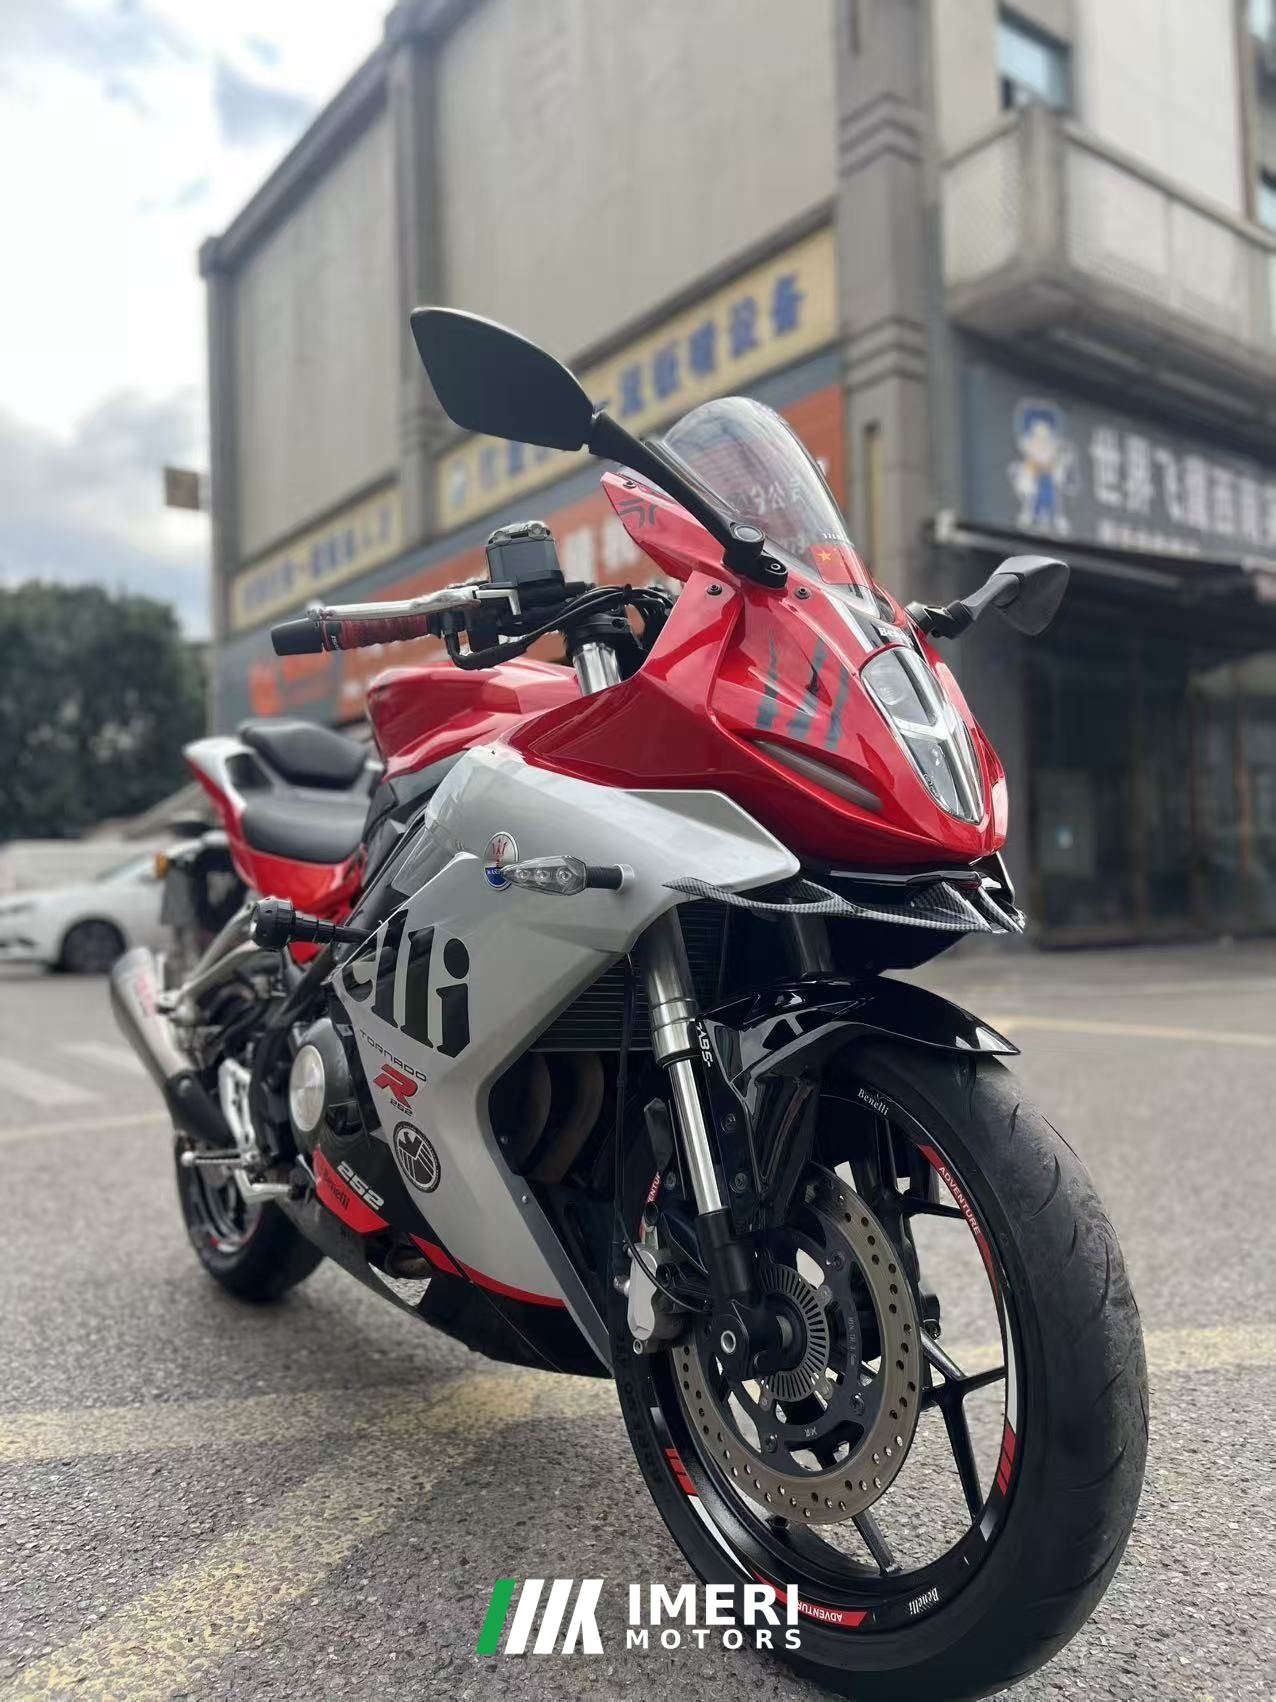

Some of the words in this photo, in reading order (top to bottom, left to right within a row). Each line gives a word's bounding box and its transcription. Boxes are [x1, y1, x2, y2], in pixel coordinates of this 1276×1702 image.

[359, 1028, 427, 1082] TORNADO
[373, 1063, 418, 1110] R
[857, 1087, 889, 1116] Benelli
[337, 1160, 385, 1211] 252
[939, 1166, 981, 1235] ADVENTURE
[908, 1587, 940, 1615] Benelli
